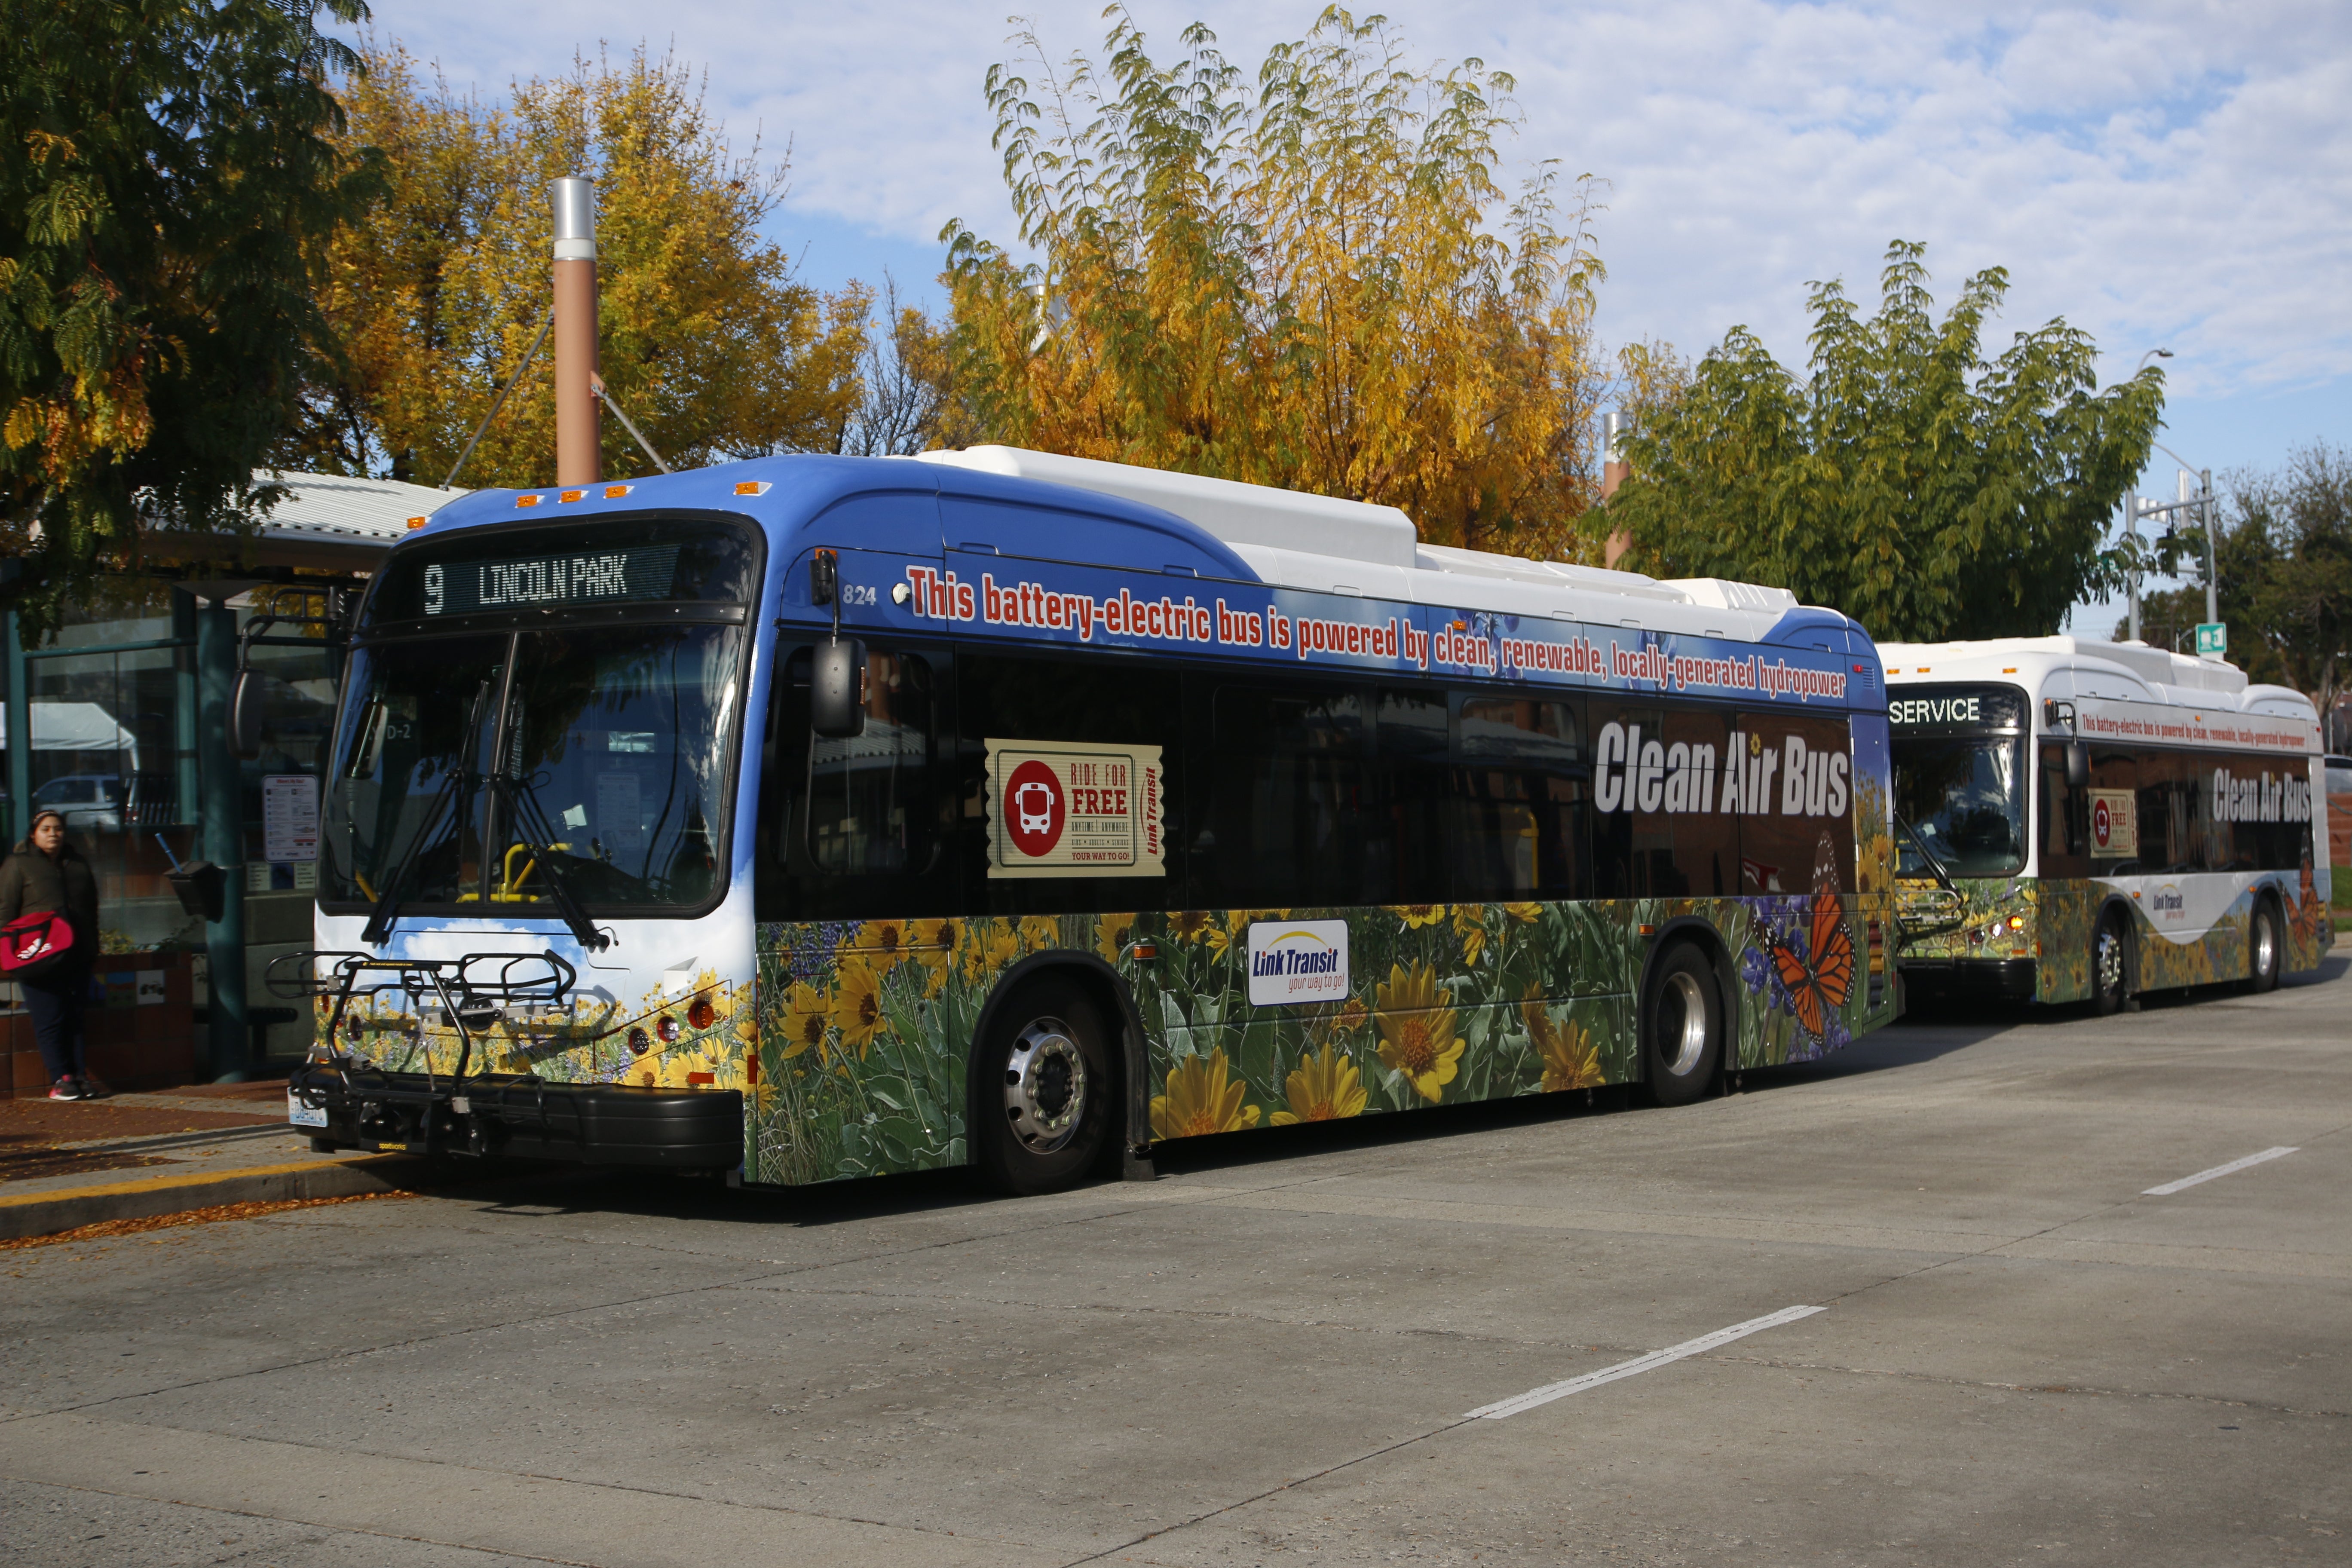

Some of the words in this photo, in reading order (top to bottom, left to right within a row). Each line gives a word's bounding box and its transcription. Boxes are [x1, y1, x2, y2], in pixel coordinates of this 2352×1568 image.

[425, 564, 444, 614] 9
[479, 559, 567, 604] LINCOLN
[572, 554, 628, 597] PARK
[842, 584, 876, 606] 824
[906, 565, 974, 620] This
[982, 573, 1210, 643] battery-electric
[1216, 598, 1262, 646] bus
[1268, 605, 1290, 649] is
[1297, 618, 1399, 661] powered
[1403, 619, 1430, 670] by
[1434, 623, 1497, 675] clean,
[1501, 636, 1608, 681] renewable,
[1611, 640, 1755, 690] locally-generated
[1758, 655, 1847, 701] hydropower
[1889, 697, 1980, 724] SERVICE
[386, 723, 411, 740] D-2
[2082, 714, 2095, 731] This
[2143, 719, 2154, 736] bus
[1070, 763, 1097, 786] RIDE
[1105, 764, 1126, 787] FOR
[1593, 720, 1715, 815] Clean
[1720, 729, 1779, 816] Air
[1781, 735, 1848, 818] Bus
[1071, 789, 1127, 815] FREE
[1145, 766, 1157, 821] Transit
[2214, 767, 2258, 822] Clean
[2260, 771, 2282, 822] Air
[2283, 772, 2311, 823] Bus
[1071, 821, 1094, 832] ANYTIME
[1101, 821, 1128, 832] ANYWHERE
[2111, 812, 2126, 826] FREE
[1146, 822, 1158, 855] Link
[1253, 949, 1285, 977] Link
[1286, 947, 1338, 975] Transit
[1288, 977, 1306, 994] your
[1307, 976, 1323, 992] way
[1324, 973, 1332, 988] to
[1333, 972, 1345, 991] go!
[379, 1142, 406, 1151] sportworks
